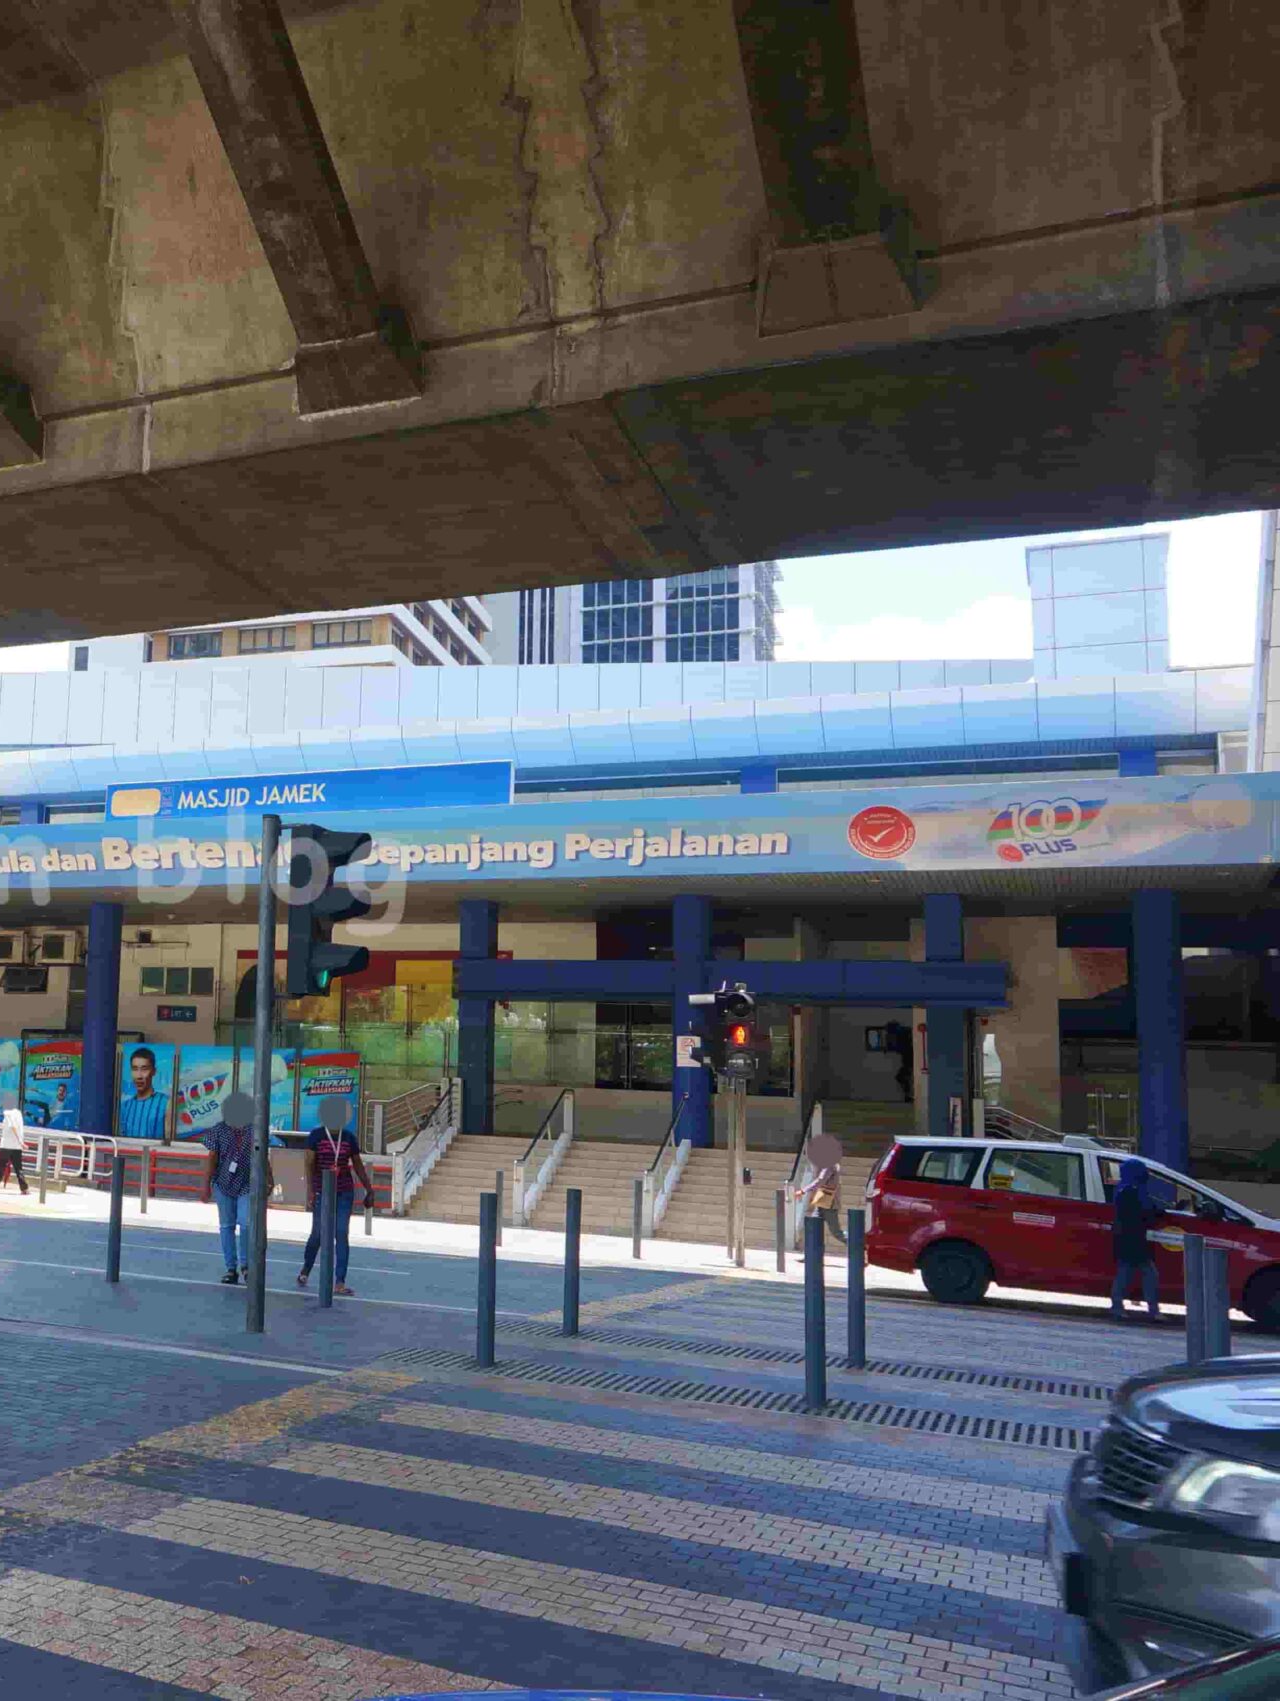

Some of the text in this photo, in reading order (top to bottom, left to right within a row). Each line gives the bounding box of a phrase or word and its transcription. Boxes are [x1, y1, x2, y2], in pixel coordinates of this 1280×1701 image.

[177, 788, 250, 809] MASJID
[255, 783, 327, 806] JAMEK
[1006, 797, 1082, 841] 100
[41, 848, 96, 873] dan
[101, 837, 291, 869] Berten
[565, 827, 790, 866] Perjalanan
[1021, 839, 1078, 857] PLUS
[190, 1100, 219, 1118] PLUS
